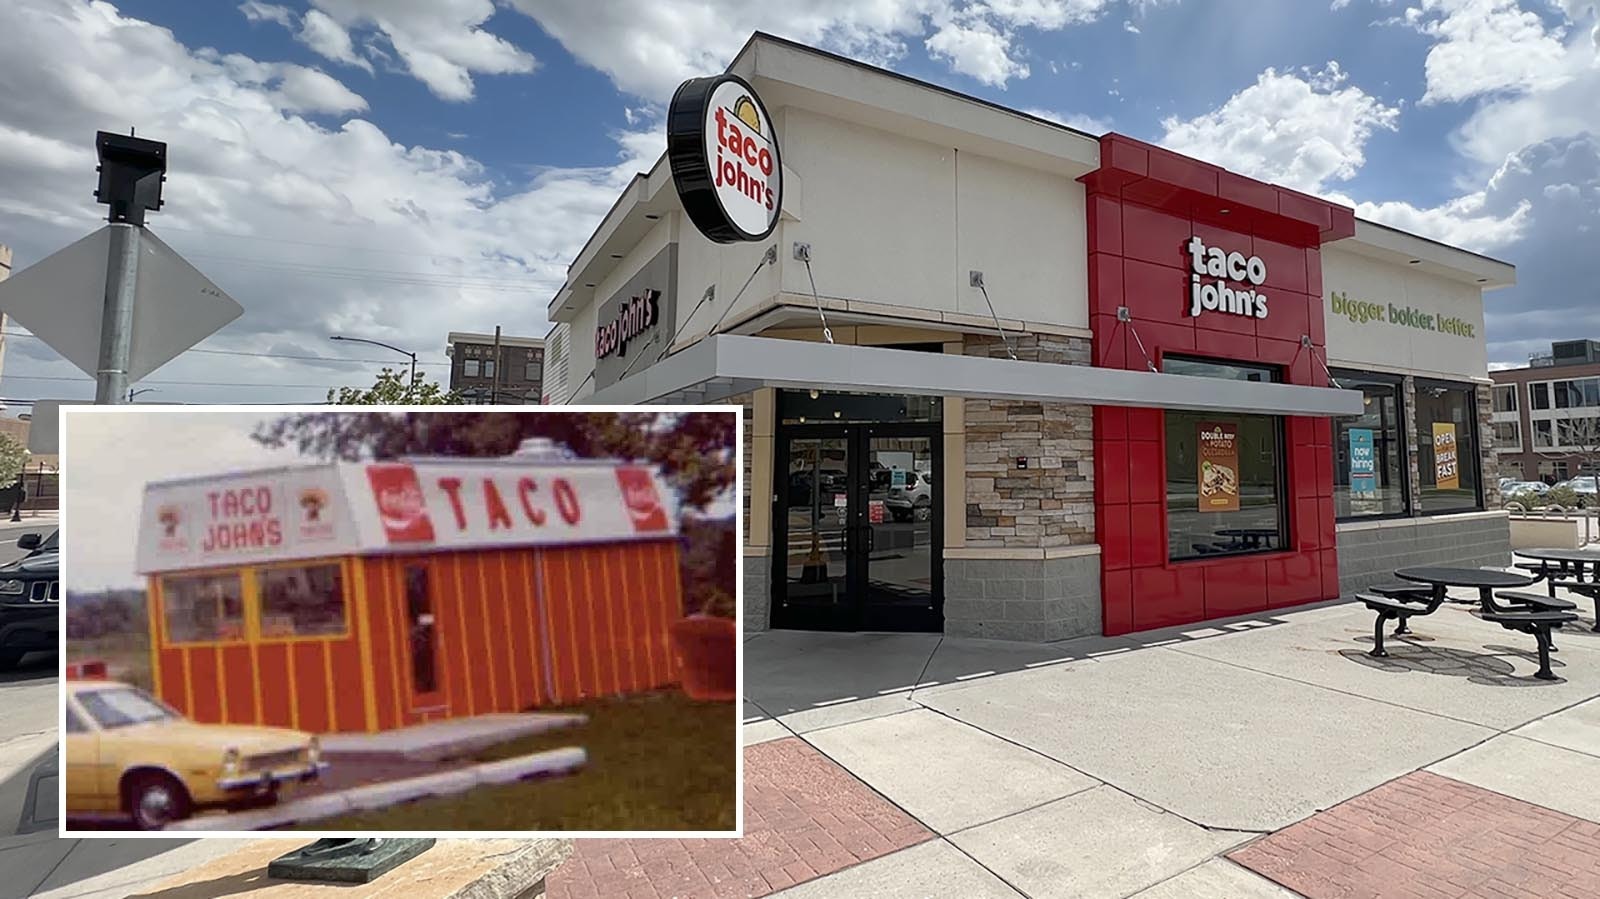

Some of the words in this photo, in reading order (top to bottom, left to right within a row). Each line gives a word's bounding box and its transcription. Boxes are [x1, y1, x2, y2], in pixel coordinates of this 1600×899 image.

[715, 106, 773, 177] taco
[715, 145, 774, 211] john's
[1189, 236, 1267, 285] taco
[1191, 274, 1269, 319] john's
[1331, 291, 1385, 323] bigger.
[1388, 302, 1435, 331] bolder.
[1437, 313, 1476, 338] better.
[595, 319, 619, 359] taco
[617, 289, 660, 357] john's
[1210, 440, 1233, 448] POTATO
[1354, 447, 1370, 456] now
[1436, 432, 1456, 445] OPEN
[1436, 451, 1456, 464] BREAK
[1352, 456, 1374, 471] hiring
[1436, 462, 1457, 479] FAST
[206, 486, 272, 519] TACO
[437, 476, 581, 530] TACO
